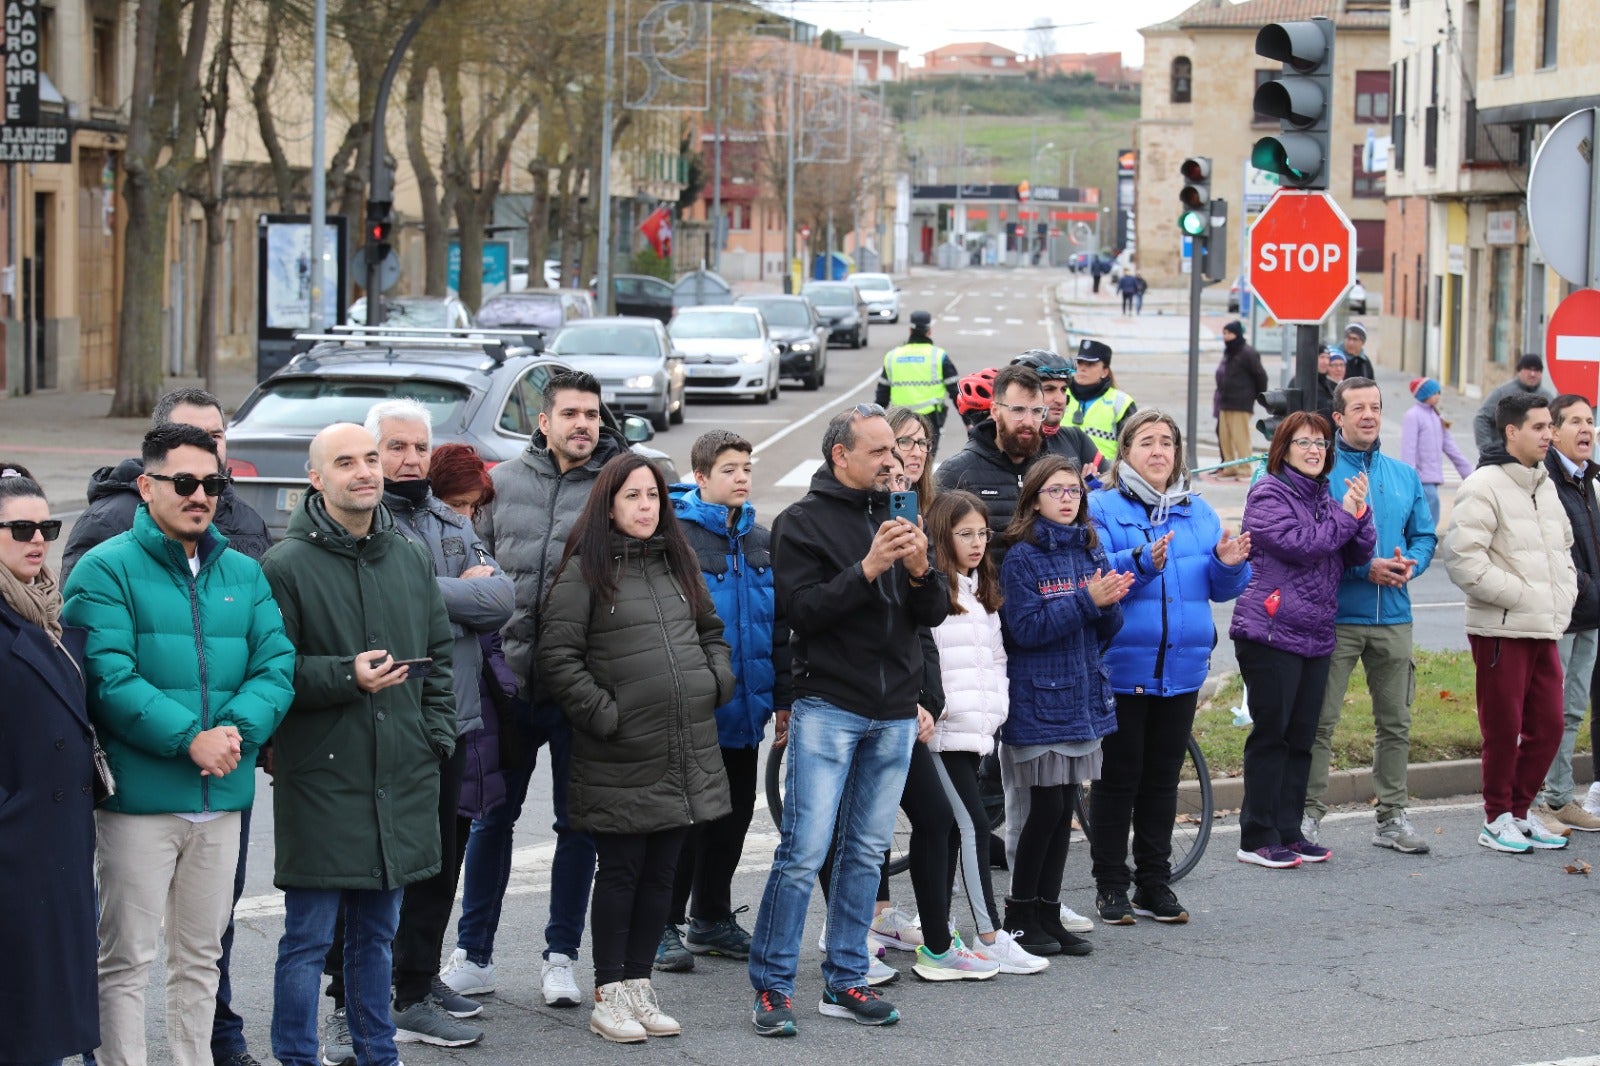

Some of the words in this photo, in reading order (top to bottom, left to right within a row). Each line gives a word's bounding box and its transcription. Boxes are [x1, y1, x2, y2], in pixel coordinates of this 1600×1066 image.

[6, 0, 21, 119] AURANTE
[2, 126, 68, 145] RANCHO
[0, 144, 56, 161] RANDE
[1258, 242, 1341, 273] STOP
